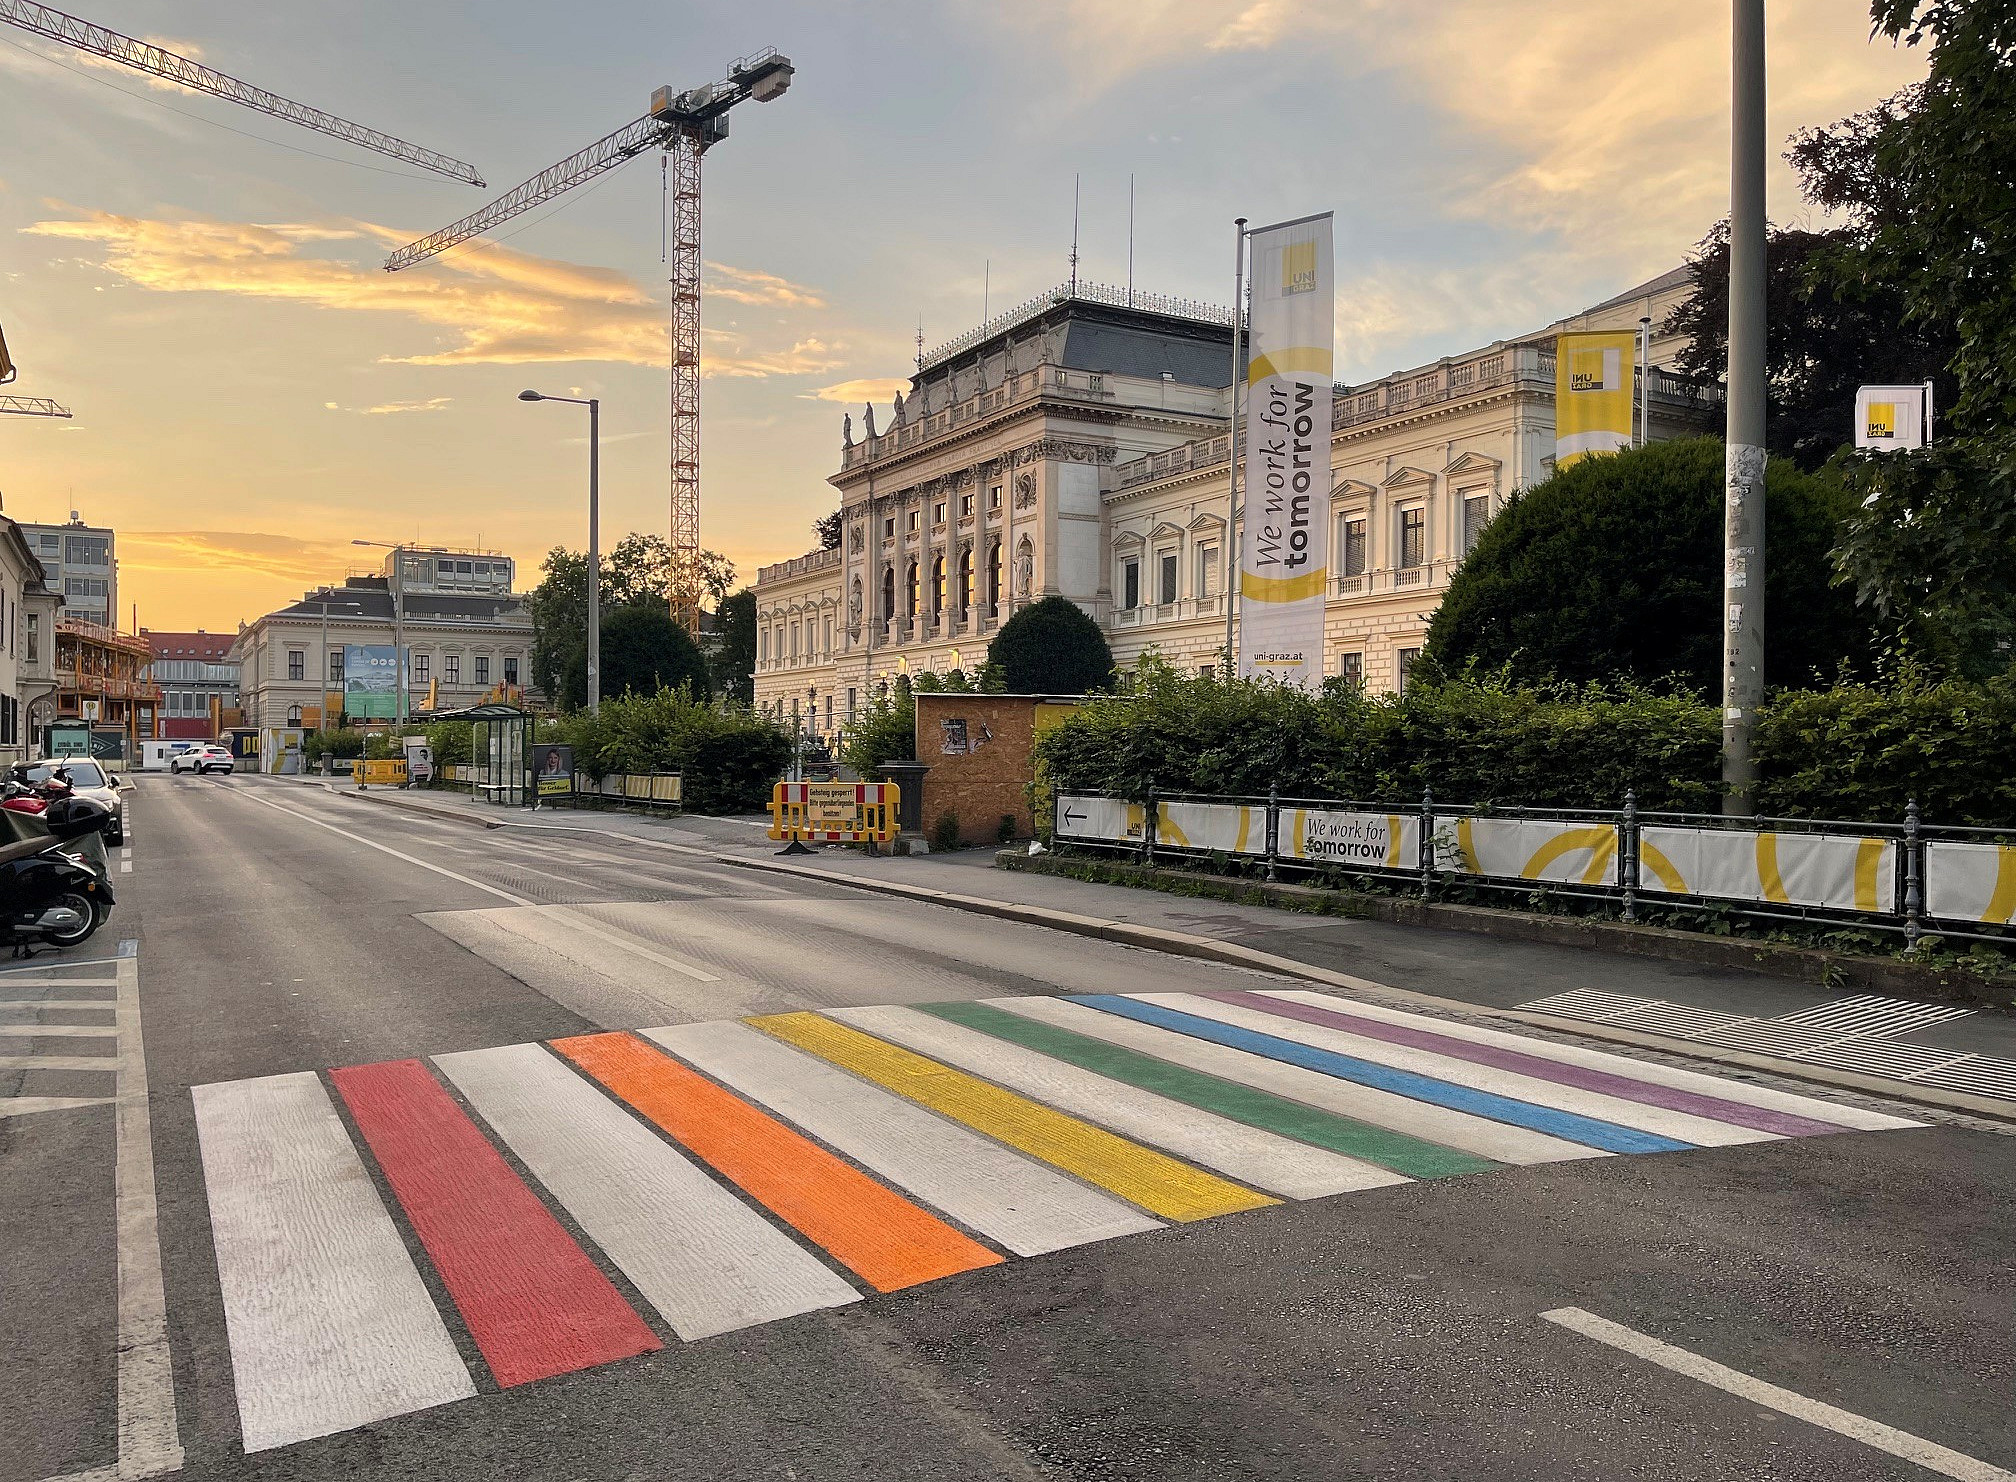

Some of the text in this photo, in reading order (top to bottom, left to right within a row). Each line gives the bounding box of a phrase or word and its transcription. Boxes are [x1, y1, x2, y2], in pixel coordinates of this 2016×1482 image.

[1293, 269, 1315, 284] UNI
[1293, 280, 1317, 293] GRAZ
[969, 437, 1002, 455] FRANCISCA
[1256, 384, 1291, 569] We work for
[1284, 382, 1314, 569] tomorrow
[1254, 651, 1303, 663] uni-graz.at
[810, 789, 830, 797] Gehsteig
[1308, 818, 1386, 842] We work for
